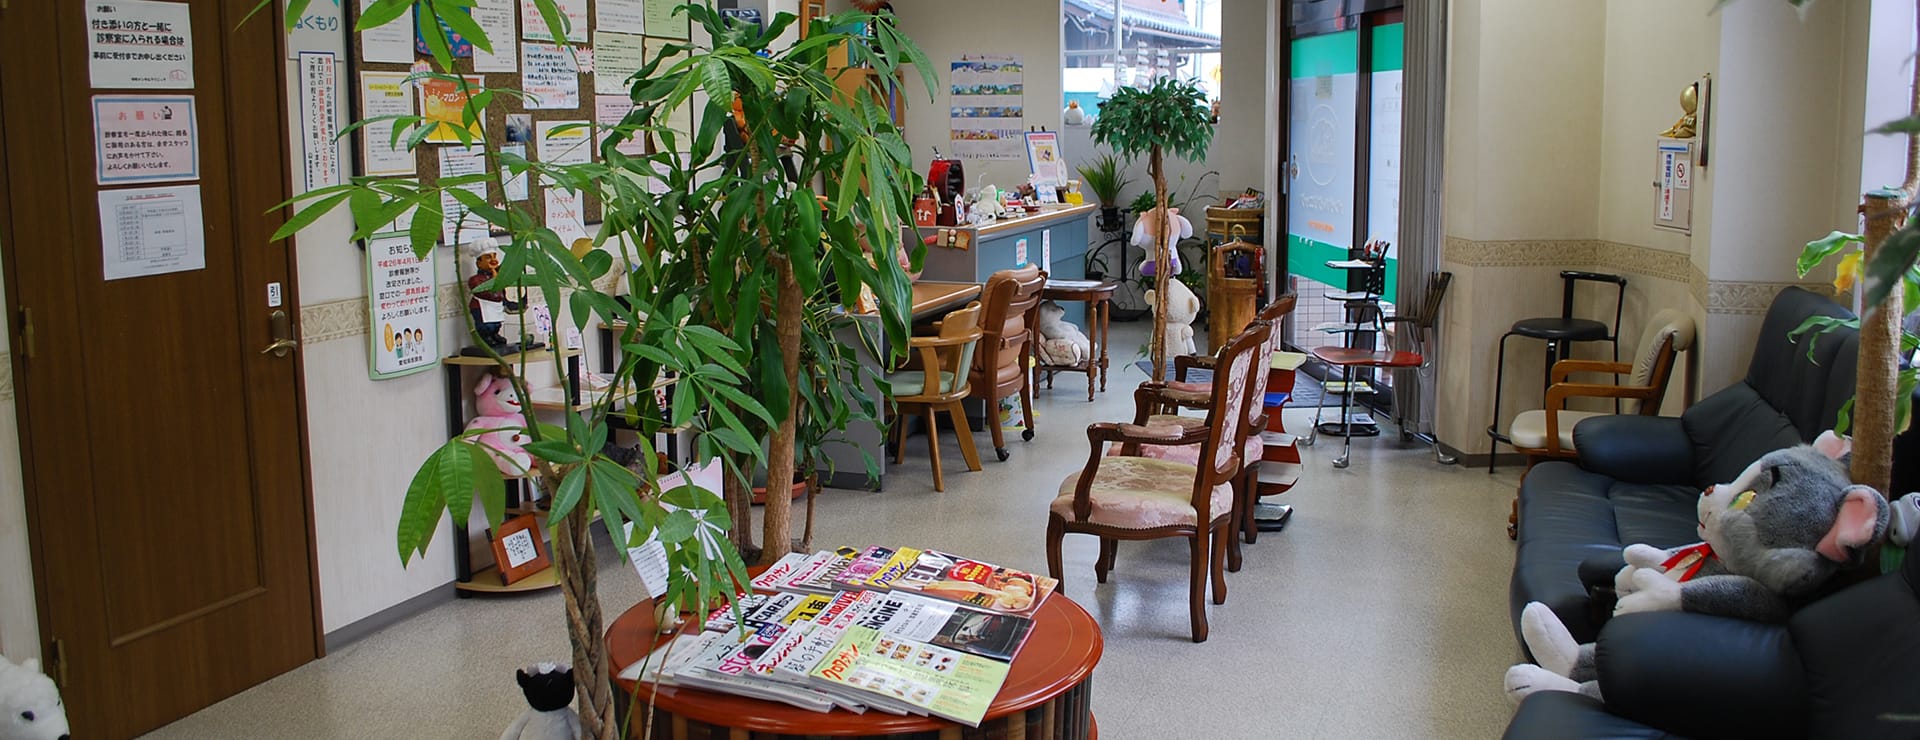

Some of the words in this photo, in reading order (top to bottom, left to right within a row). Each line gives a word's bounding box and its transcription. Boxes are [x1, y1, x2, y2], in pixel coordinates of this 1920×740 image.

[92, 19, 172, 32] 付き添いの方と一緒に
[97, 33, 184, 46] 診察室に入られる場合は
